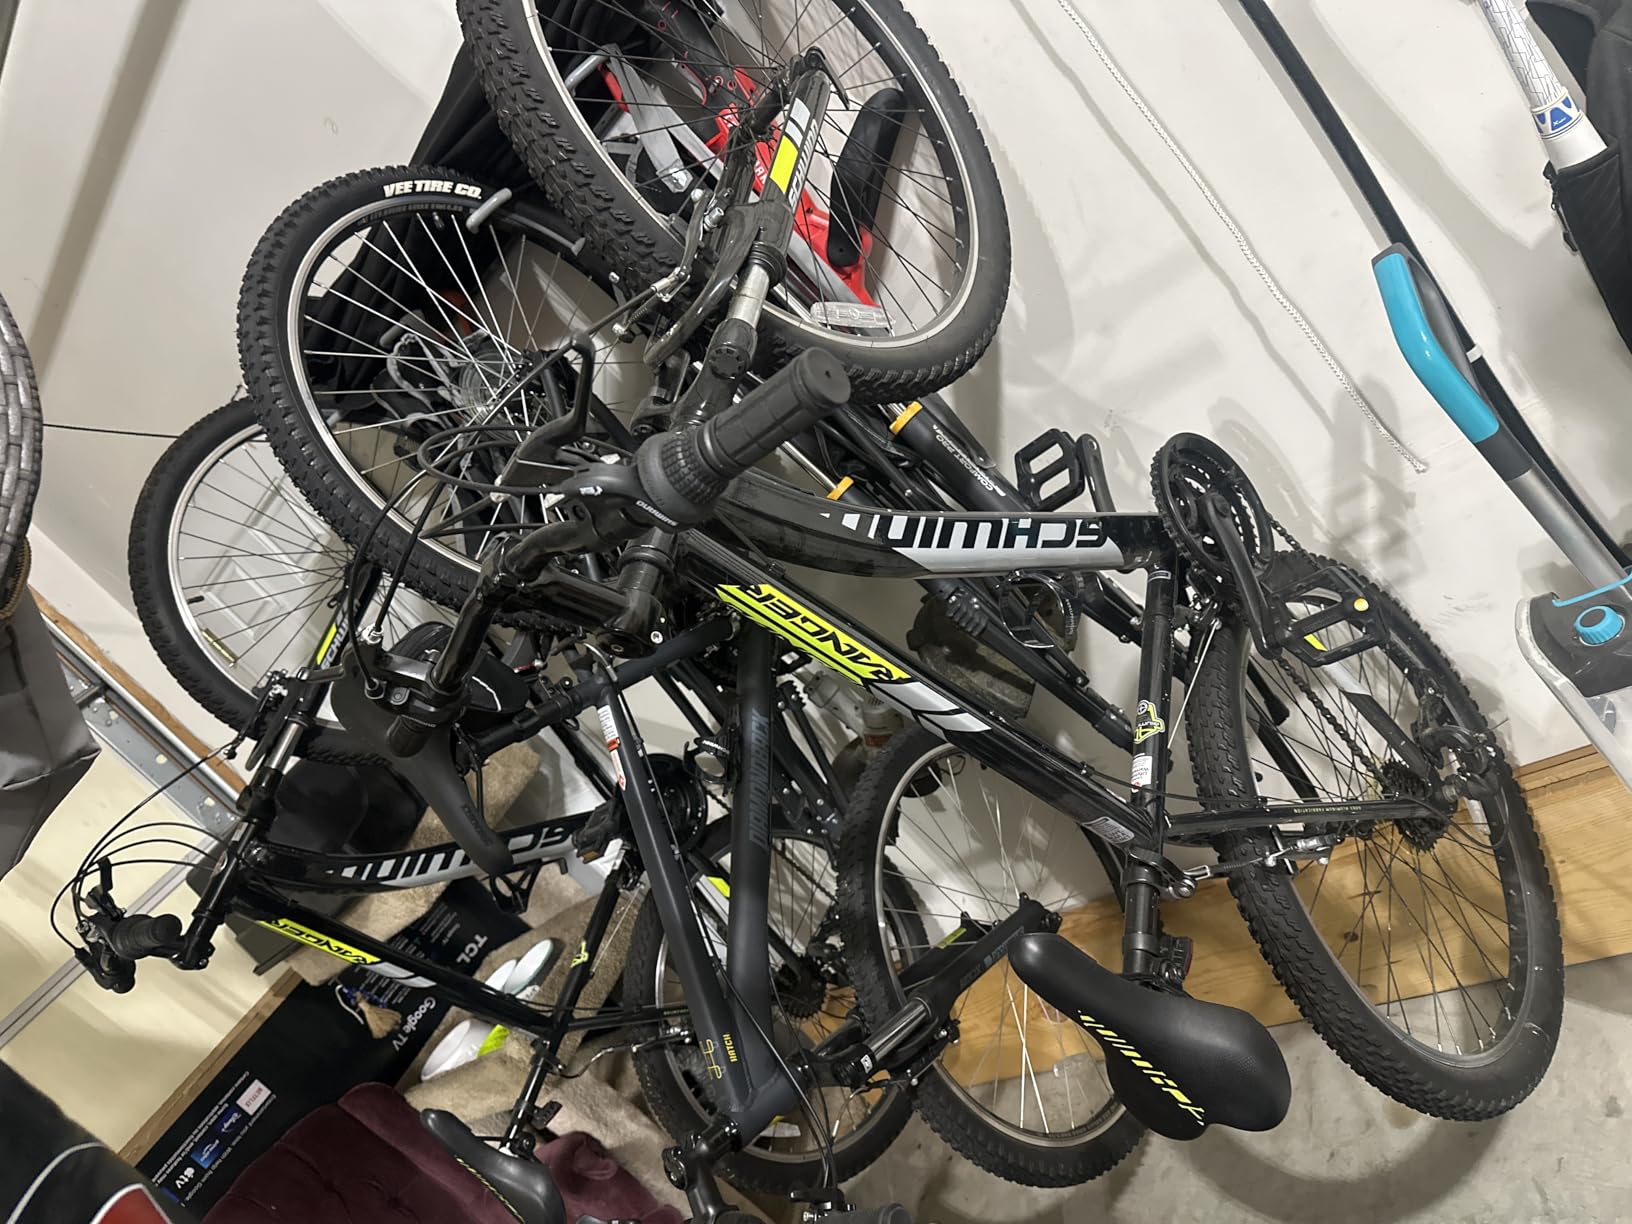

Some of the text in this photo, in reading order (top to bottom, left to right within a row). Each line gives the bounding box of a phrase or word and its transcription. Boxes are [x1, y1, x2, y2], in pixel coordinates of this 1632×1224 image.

[383, 179, 482, 199] VEE TIRE CO.
[953, 453, 993, 491] COMFORT
[738, 584, 894, 681] RANGER
[750, 707, 769, 849] DIAMONDBACK
[456, 934, 489, 964] TCL
[391, 996, 437, 1051] Google TV
[723, 1033, 738, 1063] HATCH
[245, 1087, 263, 1107] NETFLIX
